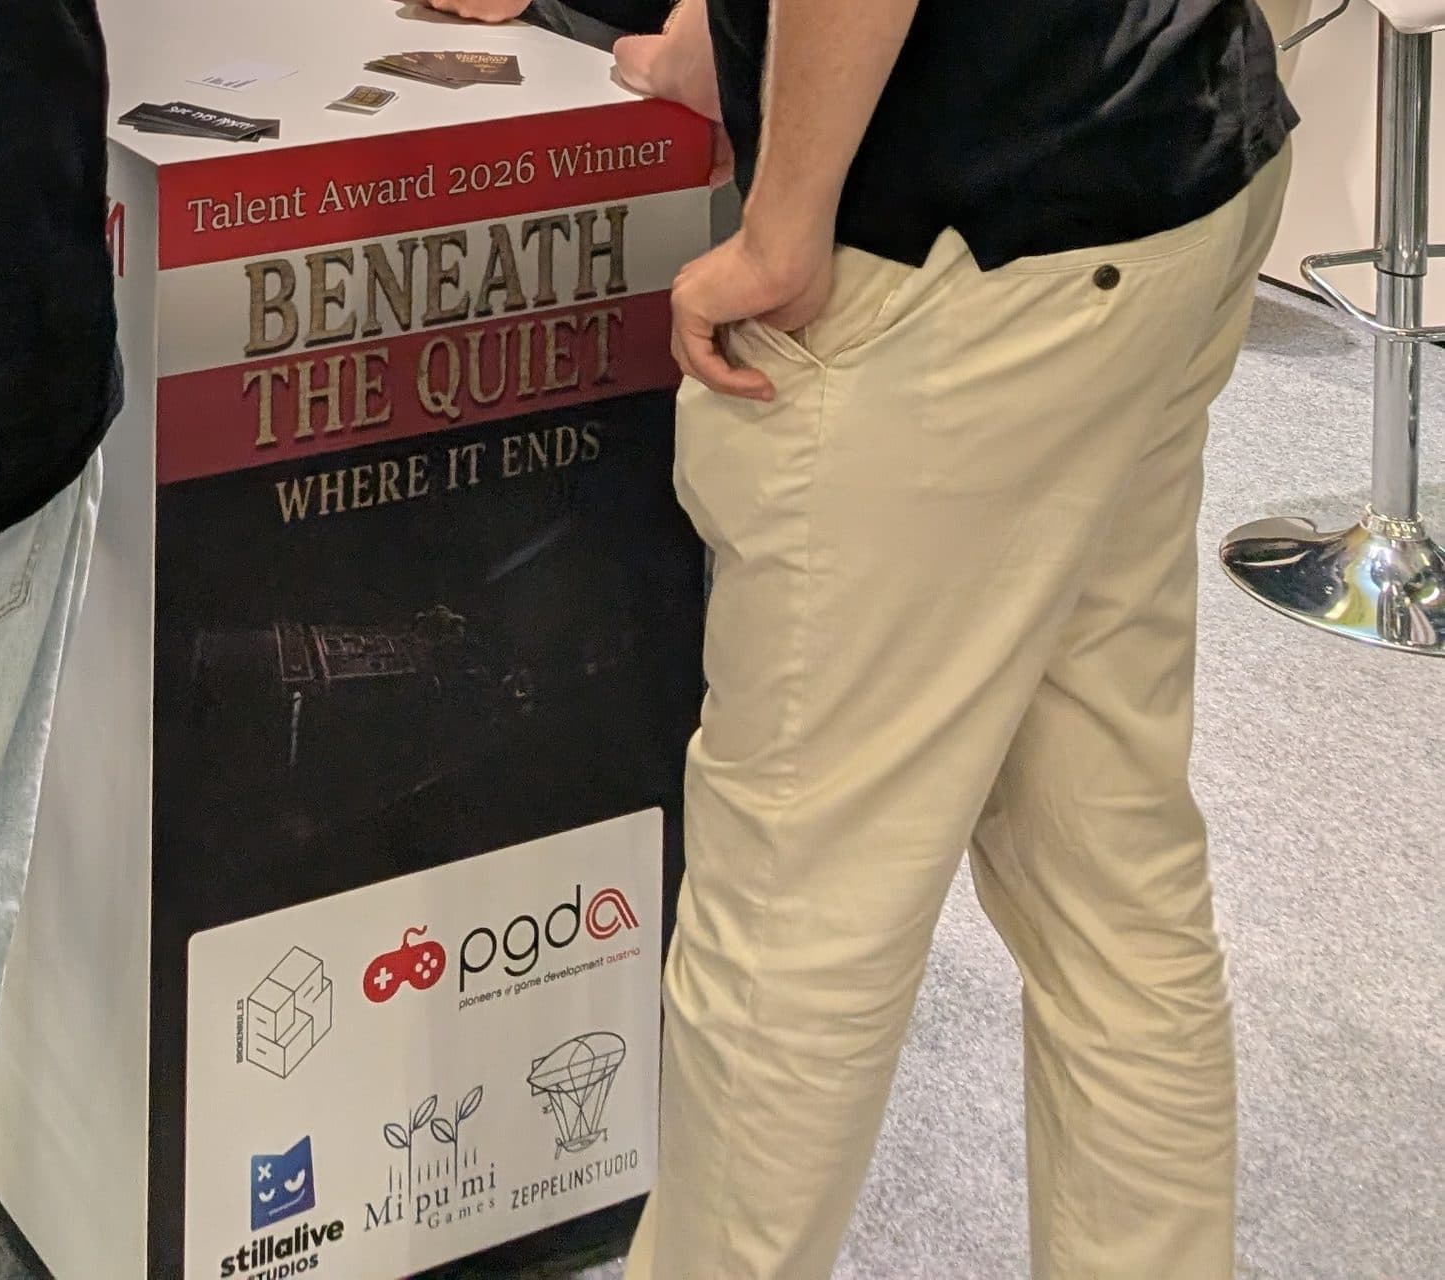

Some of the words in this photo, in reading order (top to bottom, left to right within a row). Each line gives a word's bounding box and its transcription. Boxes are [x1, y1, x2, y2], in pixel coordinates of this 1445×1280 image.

[187, 186, 307, 234] Talent
[319, 166, 435, 214] Award
[448, 151, 535, 195] 2026
[548, 136, 673, 179] Winner
[244, 204, 629, 358] BENEATH
[242, 347, 391, 450] THE
[416, 306, 623, 420] QUIET
[275, 452, 429, 524] WHERE
[446, 442, 485, 490] IT
[501, 421, 602, 476] ENDS
[458, 989, 502, 1011] pioneers
[513, 976, 541, 997] game
[543, 957, 604, 984] development
[459, 884, 639, 992] pgda
[427, 1196, 496, 1230] Games
[511, 1149, 639, 1210] ZEPPELINSTUDIO
[220, 1218, 345, 1278] stillalive
